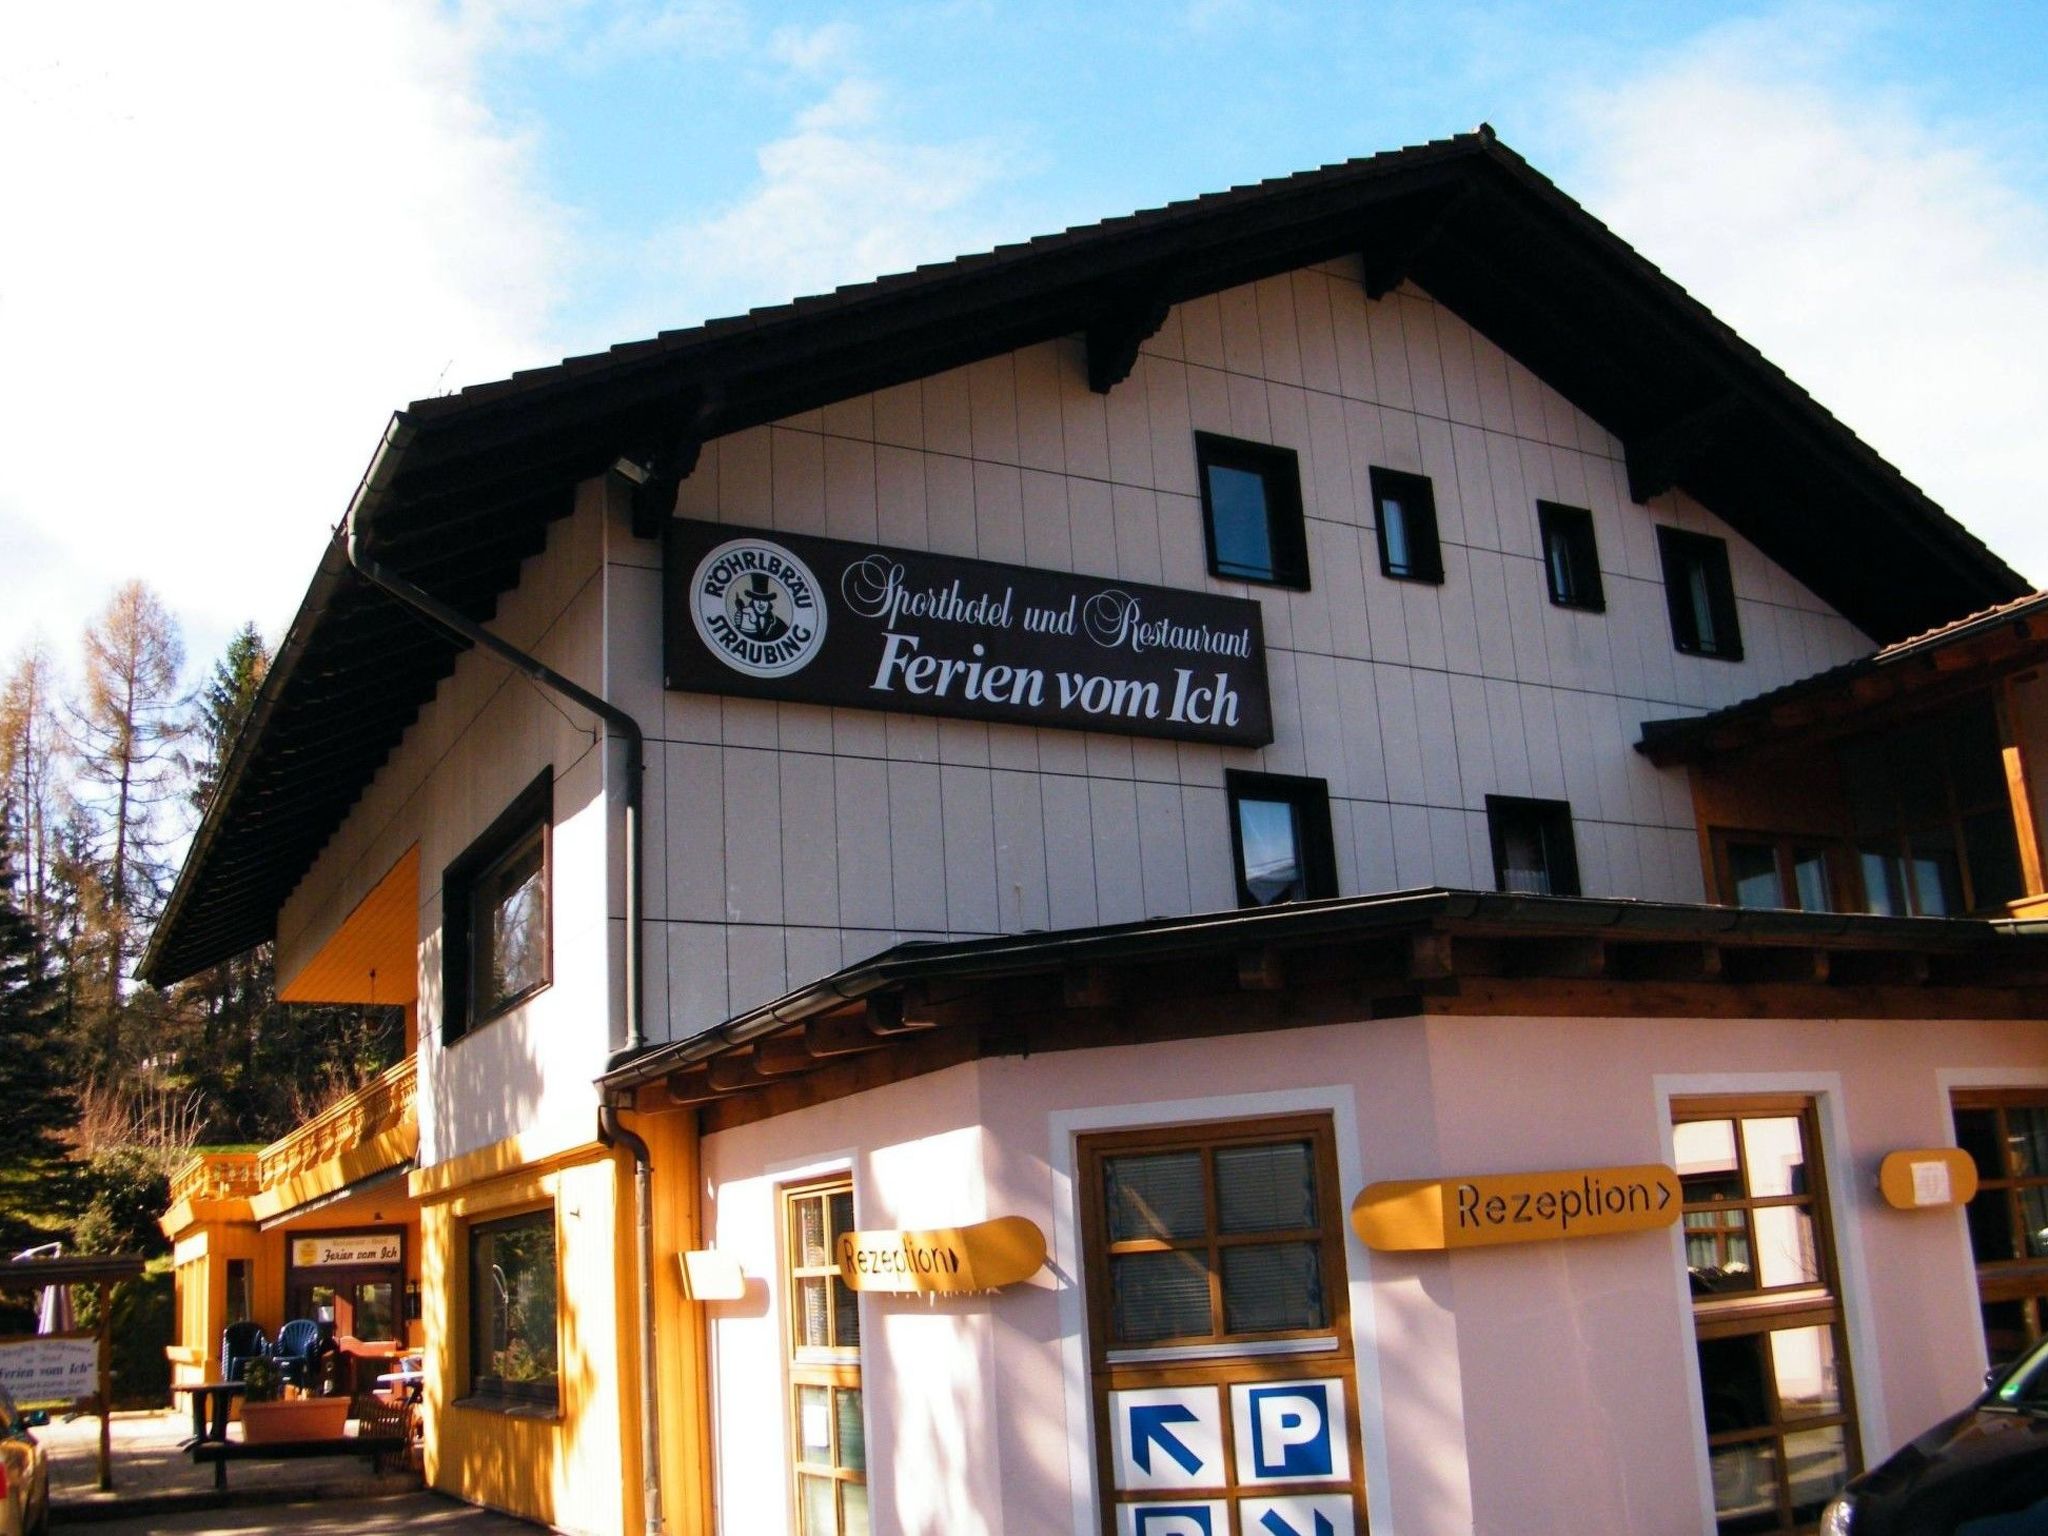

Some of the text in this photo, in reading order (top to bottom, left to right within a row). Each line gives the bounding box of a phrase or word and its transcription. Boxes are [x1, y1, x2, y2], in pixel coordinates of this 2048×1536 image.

[704, 551, 812, 609] RÖHRLBRÄU
[841, 554, 1251, 659] Sporthotel und Restaurant
[707, 614, 811, 664] STRAUBING
[869, 632, 1240, 727] Ferien vom Ich
[322, 1246, 397, 1263] Ferien vom Ich
[1259, 1396, 1321, 1467] P
